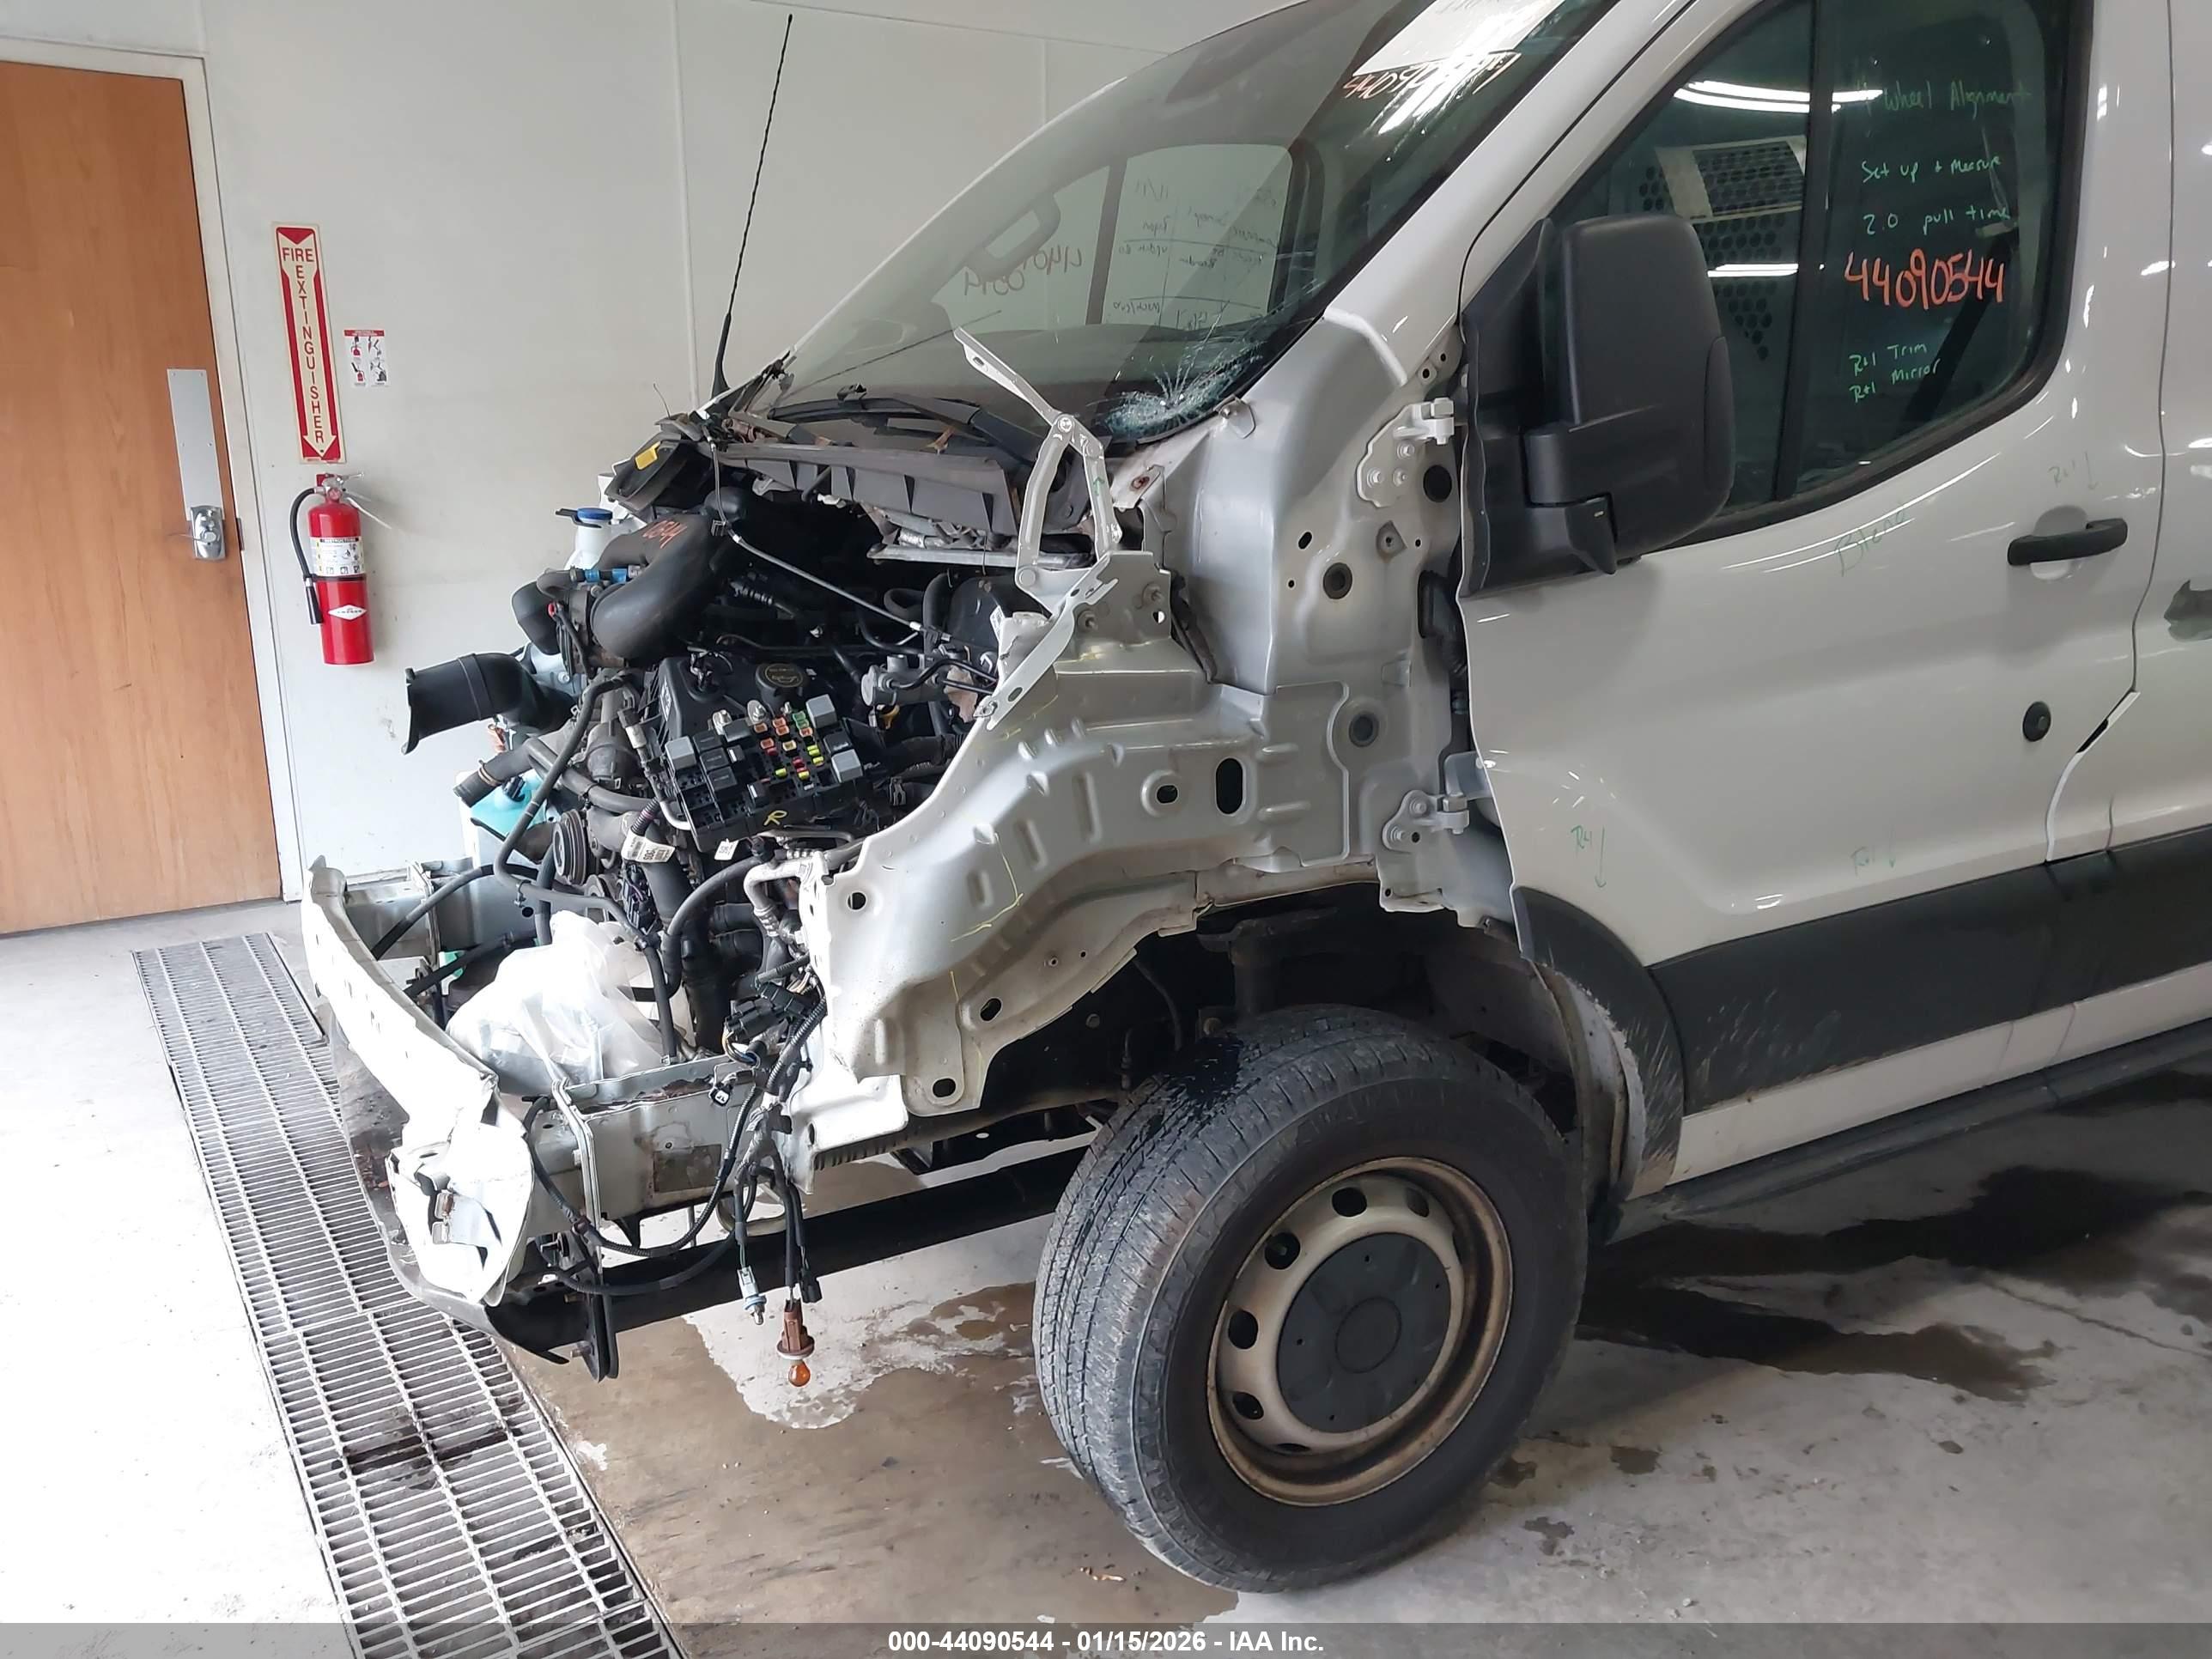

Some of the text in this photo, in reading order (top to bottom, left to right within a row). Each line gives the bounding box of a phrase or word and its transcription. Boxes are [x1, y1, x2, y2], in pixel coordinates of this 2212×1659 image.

[1861, 160, 1890, 183] Set
[1899, 161, 1919, 183] up
[1923, 209, 1954, 235] pull
[1965, 204, 2010, 222] time
[282, 246, 314, 263] FIRE
[1844, 247, 2005, 310] 44090544
[295, 264, 325, 444] EXTINGUISHER
[1887, 343, 1927, 360] Trim
[1891, 358, 1941, 385] Mirror
[763, 810, 788, 826] R
